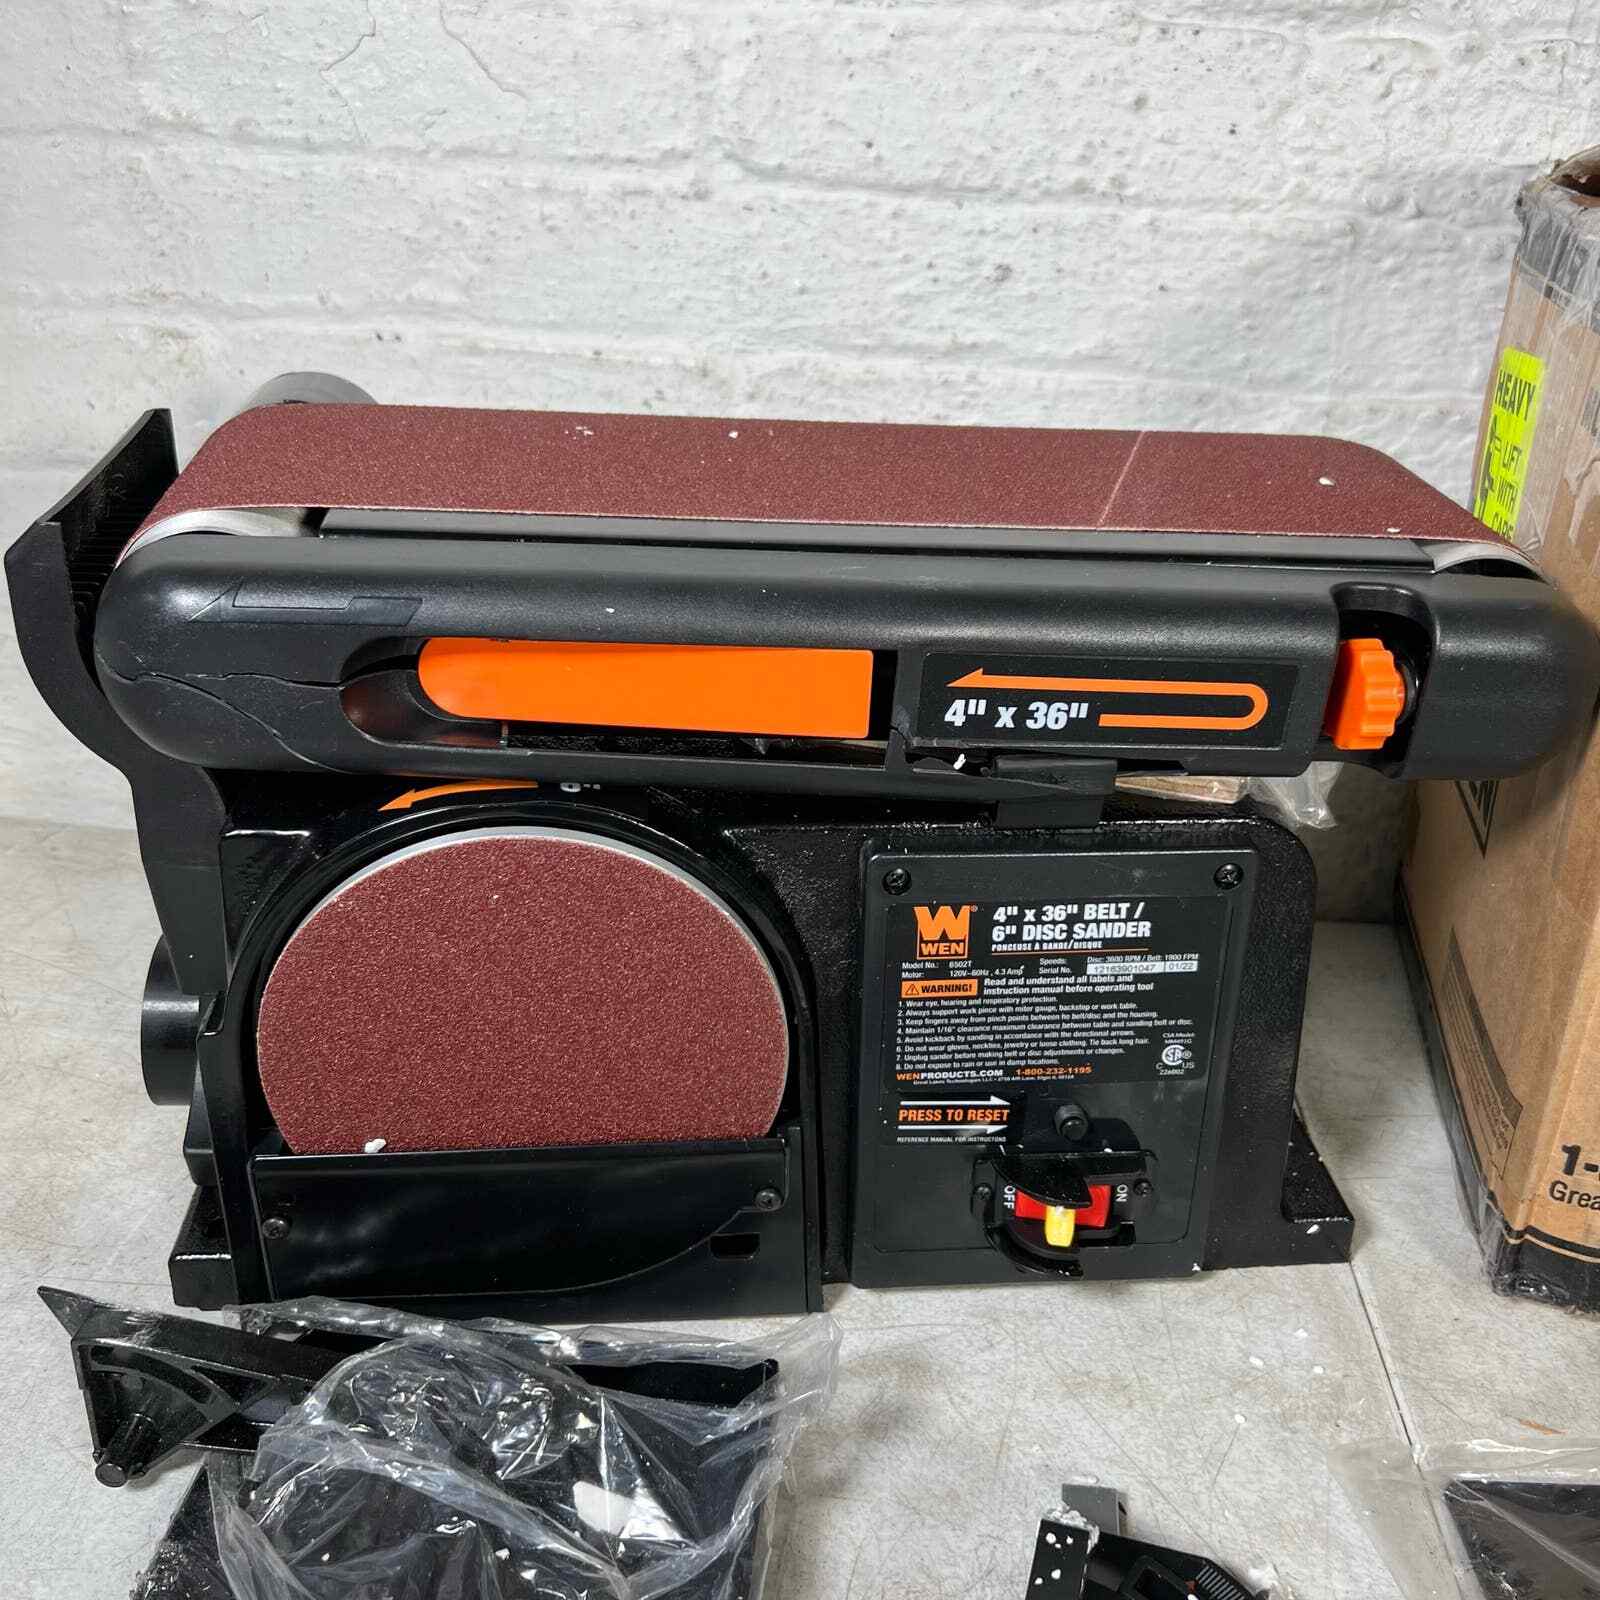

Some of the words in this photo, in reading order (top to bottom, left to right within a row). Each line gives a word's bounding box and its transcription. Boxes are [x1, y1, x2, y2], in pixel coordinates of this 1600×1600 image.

[1494, 370, 1536, 420] HEAVY
[1502, 441, 1522, 472] LIFT
[1497, 476, 1519, 512] WITH
[944, 699, 986, 727] 4"
[995, 706, 1016, 728] x
[1026, 702, 1088, 730] 36"
[993, 906, 1017, 922] 4"
[1024, 908, 1035, 921] x
[1042, 905, 1078, 920] 36"
[1084, 903, 1130, 920] BELT
[992, 925, 1016, 941] 6"
[1023, 923, 1068, 940] DISC
[1072, 921, 1151, 938] SANDER
[920, 943, 964, 955] WEN
[922, 984, 971, 993] WARNING!
[1008, 977, 1024, 985] and
[1027, 976, 1074, 985] understand
[1090, 975, 1114, 983] labels
[984, 987, 1030, 995] instruction
[1032, 985, 1063, 993] manual
[1066, 984, 1093, 993] before
[1095, 984, 1135, 992] operating
[896, 1069, 1003, 1081] WENPRODUCTS.COM
[899, 1110, 941, 1121] PRESS
[947, 1109, 963, 1121] TO
[967, 1109, 1010, 1121] RESET
[1004, 1185, 1016, 1210] OFF
[1116, 1184, 1127, 1202] ON
